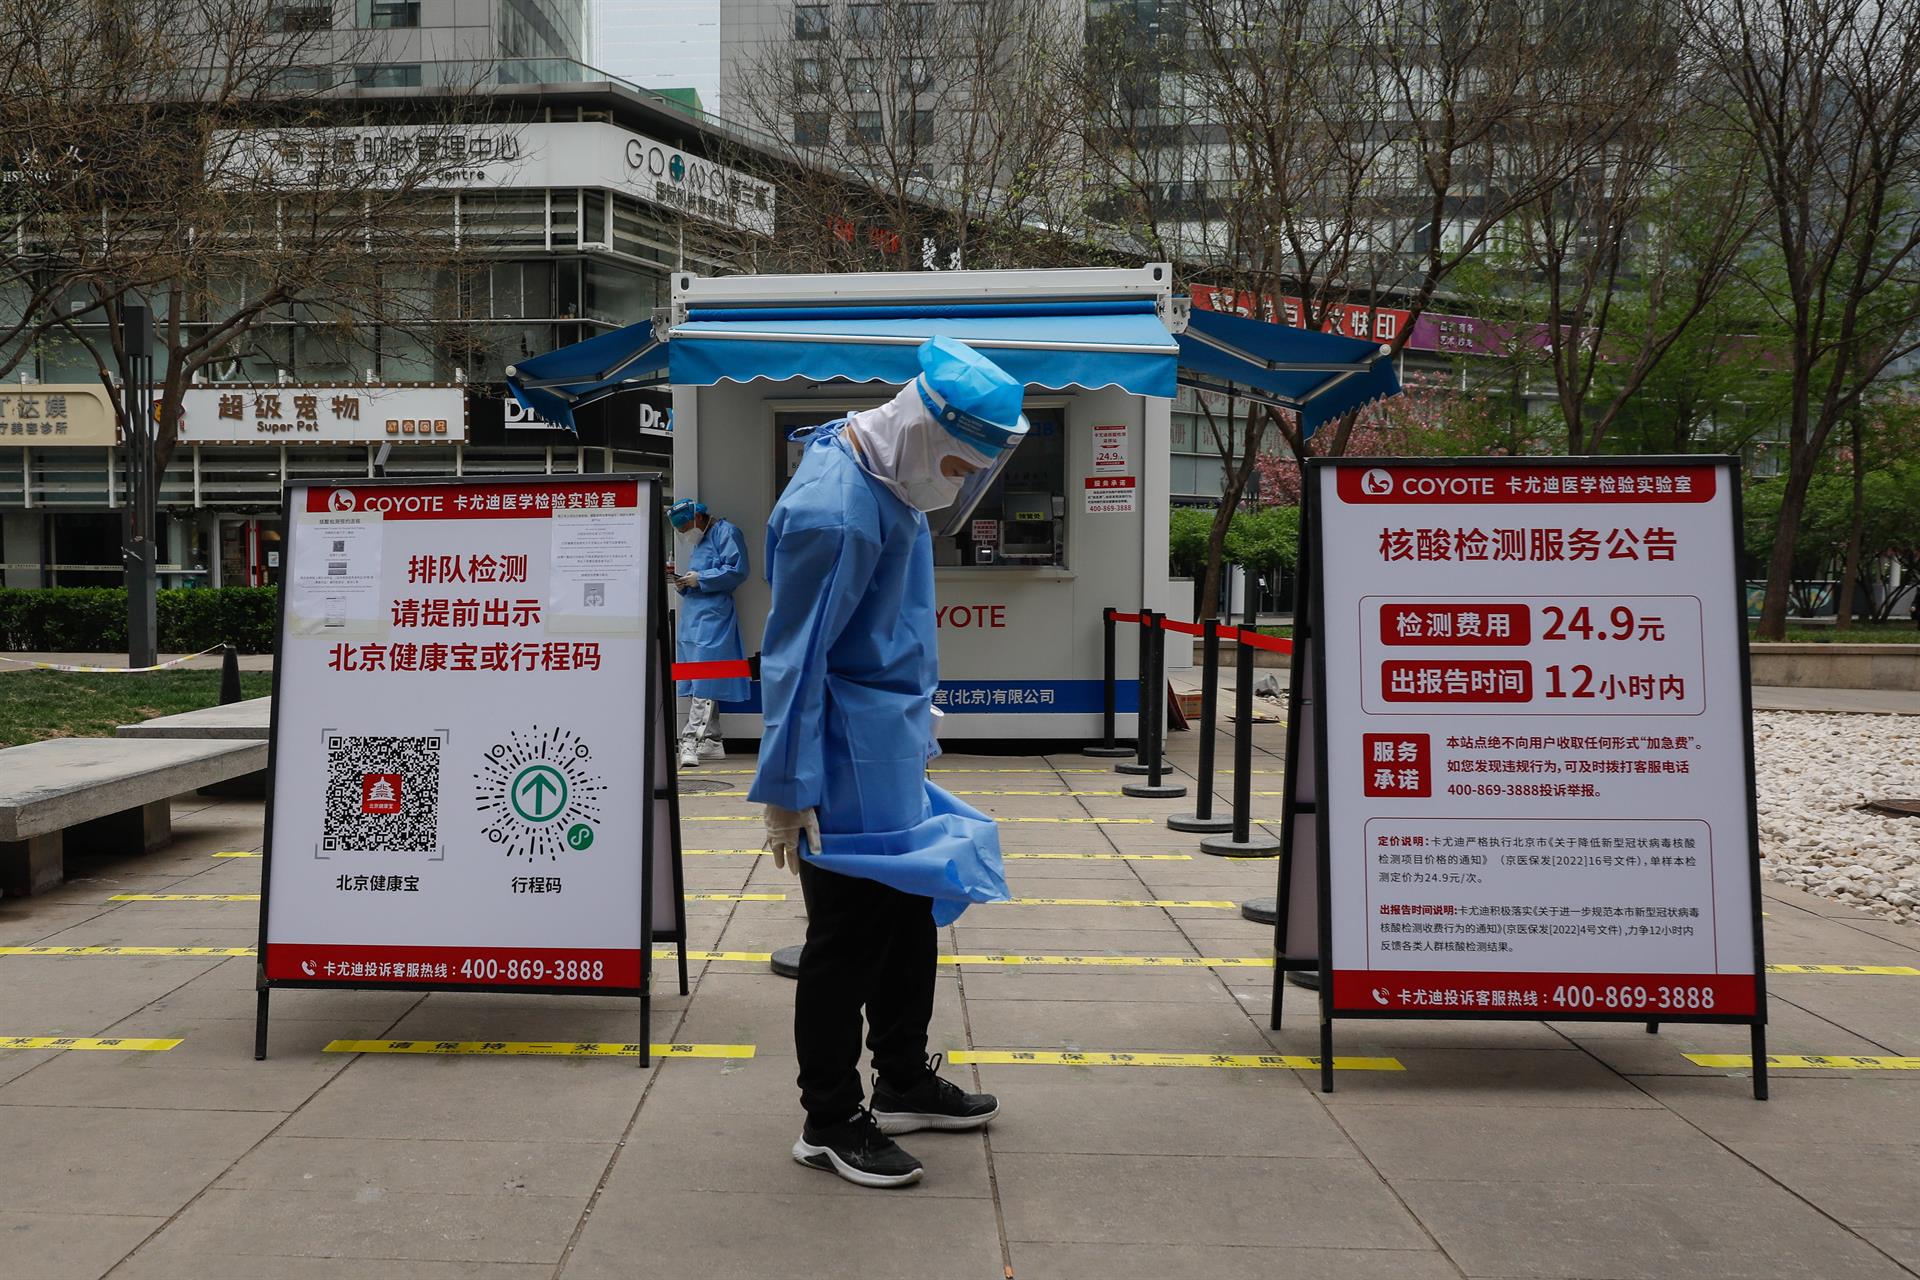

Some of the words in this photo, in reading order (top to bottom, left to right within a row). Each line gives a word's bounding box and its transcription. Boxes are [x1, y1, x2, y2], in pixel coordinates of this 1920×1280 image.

[436, 168, 485, 181] Centre
[218, 393, 360, 420] 超级宠物
[257, 420, 293, 434] Super
[297, 420, 319, 432] Pet
[1402, 477, 1494, 496] COYOTE
[1505, 475, 1692, 494] 卡尤迪医学检验实验室
[363, 496, 443, 512] COYOTE
[453, 491, 616, 511] 卡尤迪医学检验实验室
[1379, 527, 1677, 562] 核酸检测服务公告
[408, 554, 528, 584] 排队检测
[391, 598, 541, 628] 请提前出示
[1396, 611, 1511, 638] 检测费用
[1542, 605, 1665, 642] 24.9元
[328, 641, 601, 672] 北京健康宝或行程码
[1391, 668, 1524, 695] 出报告时间
[1545, 664, 1685, 701] 12小时内
[1373, 740, 1418, 763] 服务
[1373, 768, 1419, 791] 承诺
[336, 874, 420, 892] 北京健康宝
[511, 876, 562, 894] 行程码
